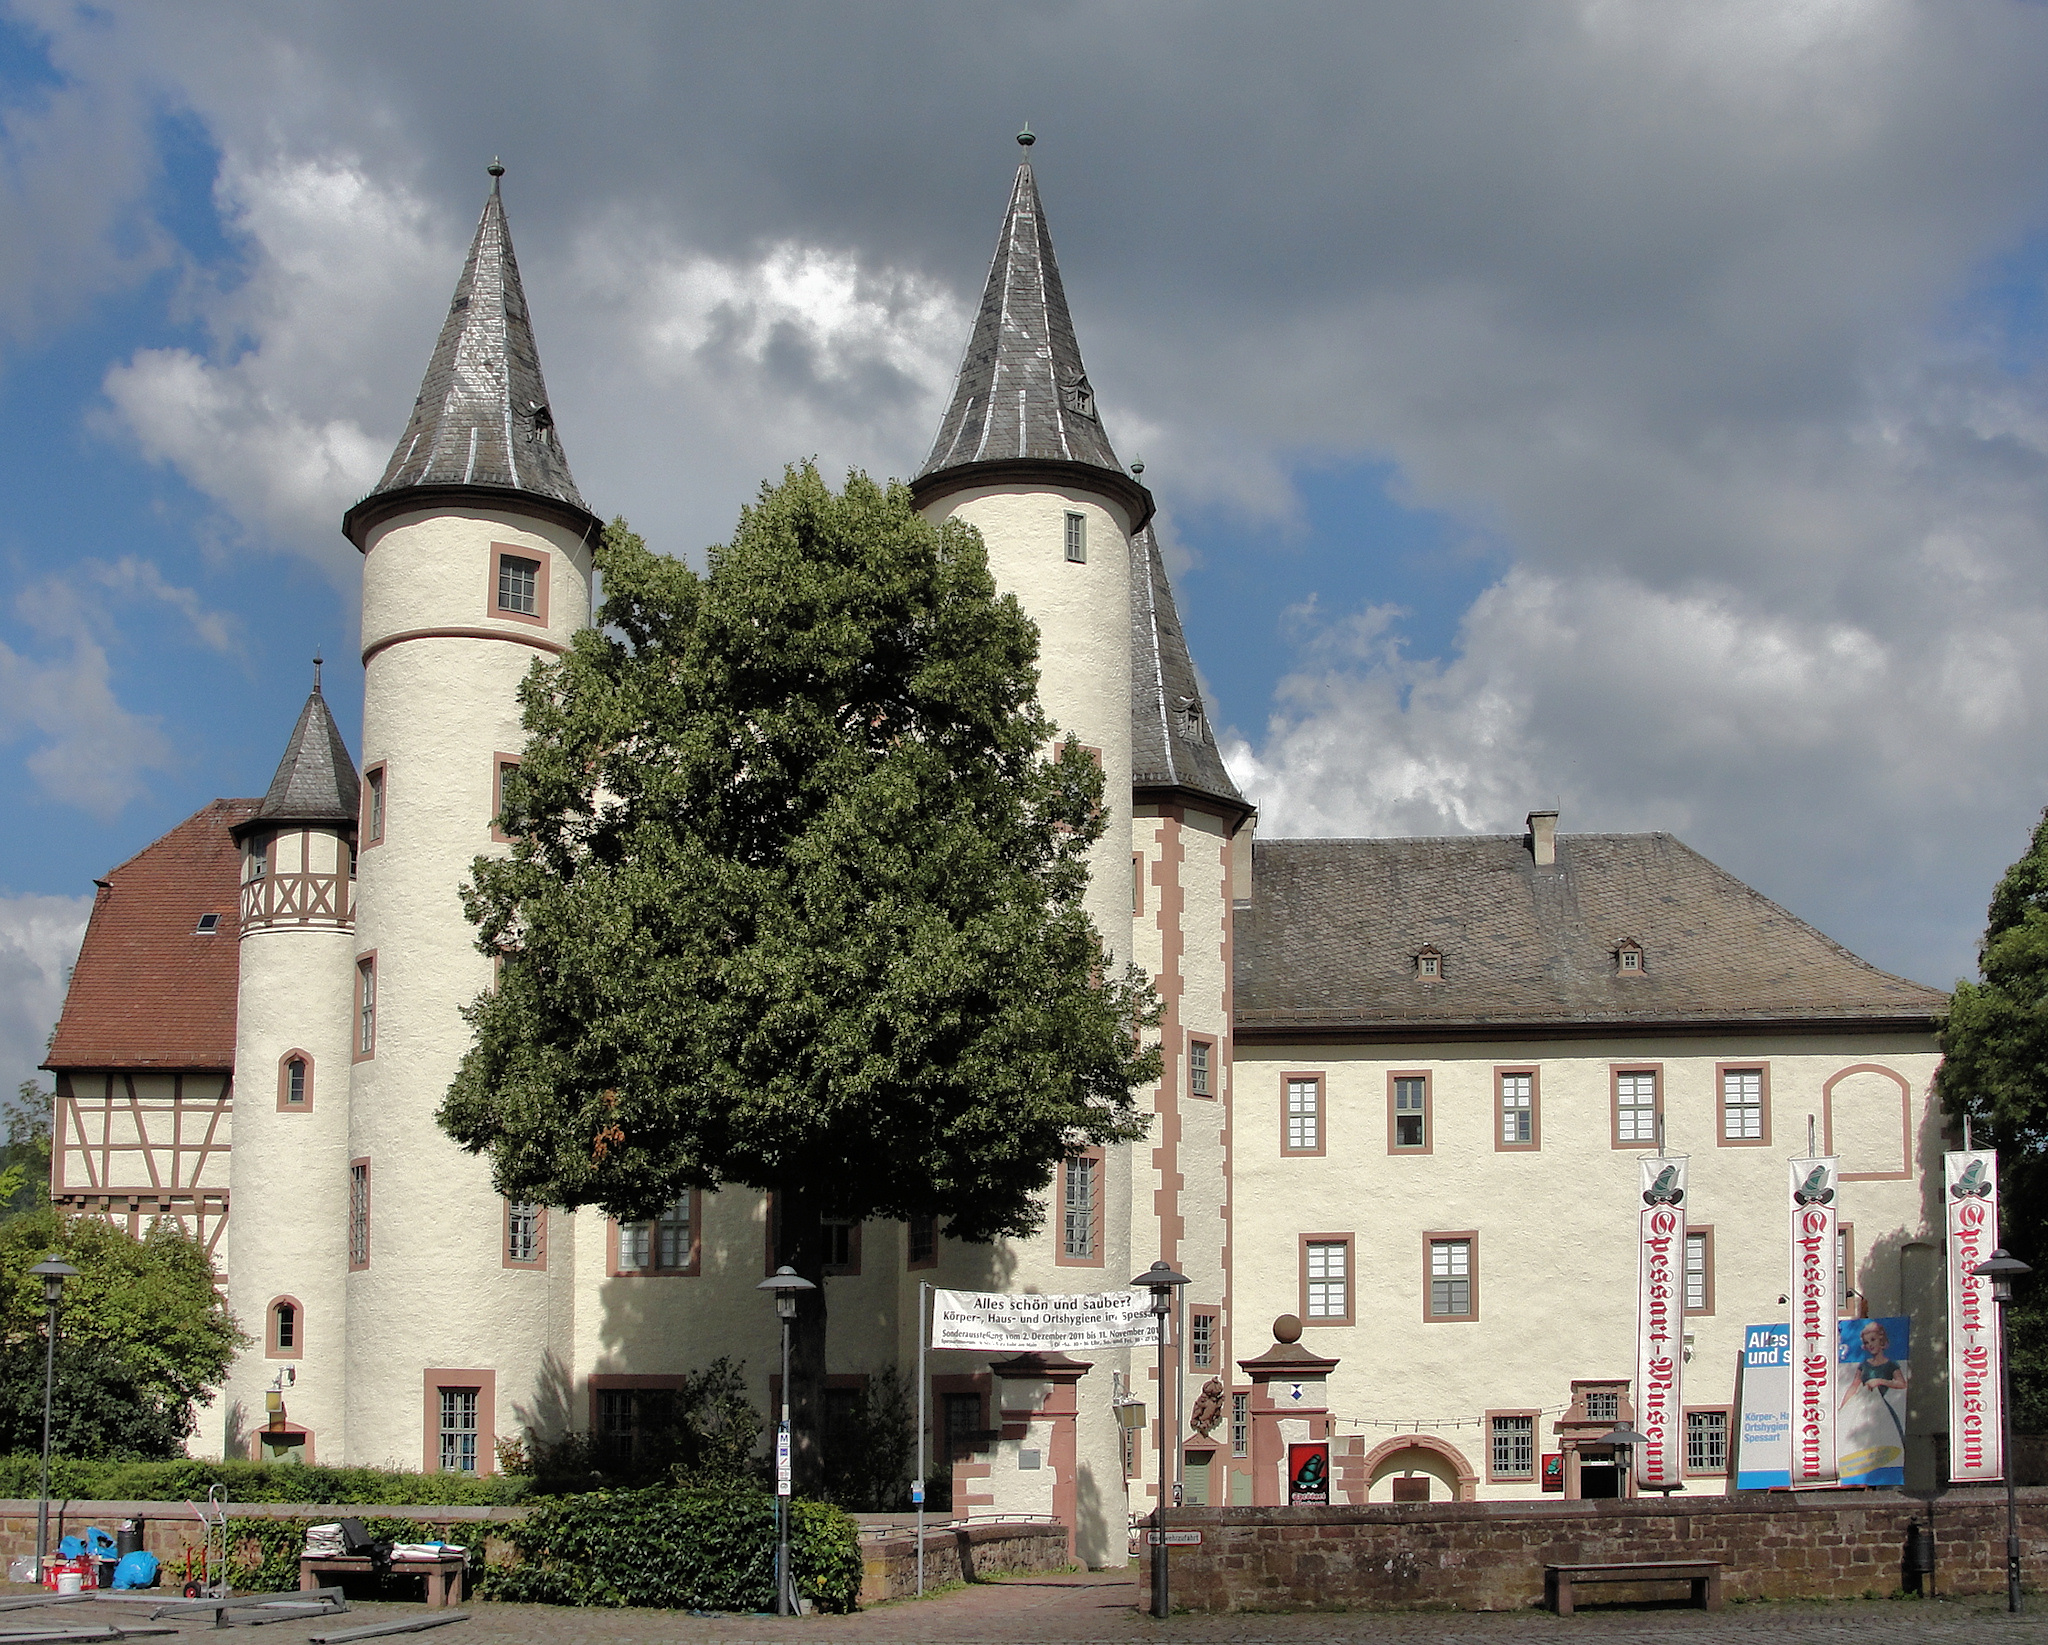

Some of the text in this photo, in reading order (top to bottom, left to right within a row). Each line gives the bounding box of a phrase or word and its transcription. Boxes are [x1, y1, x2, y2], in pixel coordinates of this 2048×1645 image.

[973, 1296, 1131, 1310] Alles schön und sauber?
[943, 1311, 985, 1324] Körper-,
[988, 1313, 1016, 1324] Haus-
[1020, 1313, 1039, 1323] und
[1042, 1312, 1101, 1326] Ortshygiene
[1031, 1331, 1067, 1341] Dezember
[1069, 1332, 1084, 1340] 2011
[1086, 1331, 1096, 1339] bis
[1109, 1327, 1144, 1338] November
[1146, 1326, 1159, 1335] 201
[1748, 1348, 1778, 1364] und
[1745, 1422, 1789, 1433] Ortshygien
[1744, 1433, 1780, 1443] Spessart
